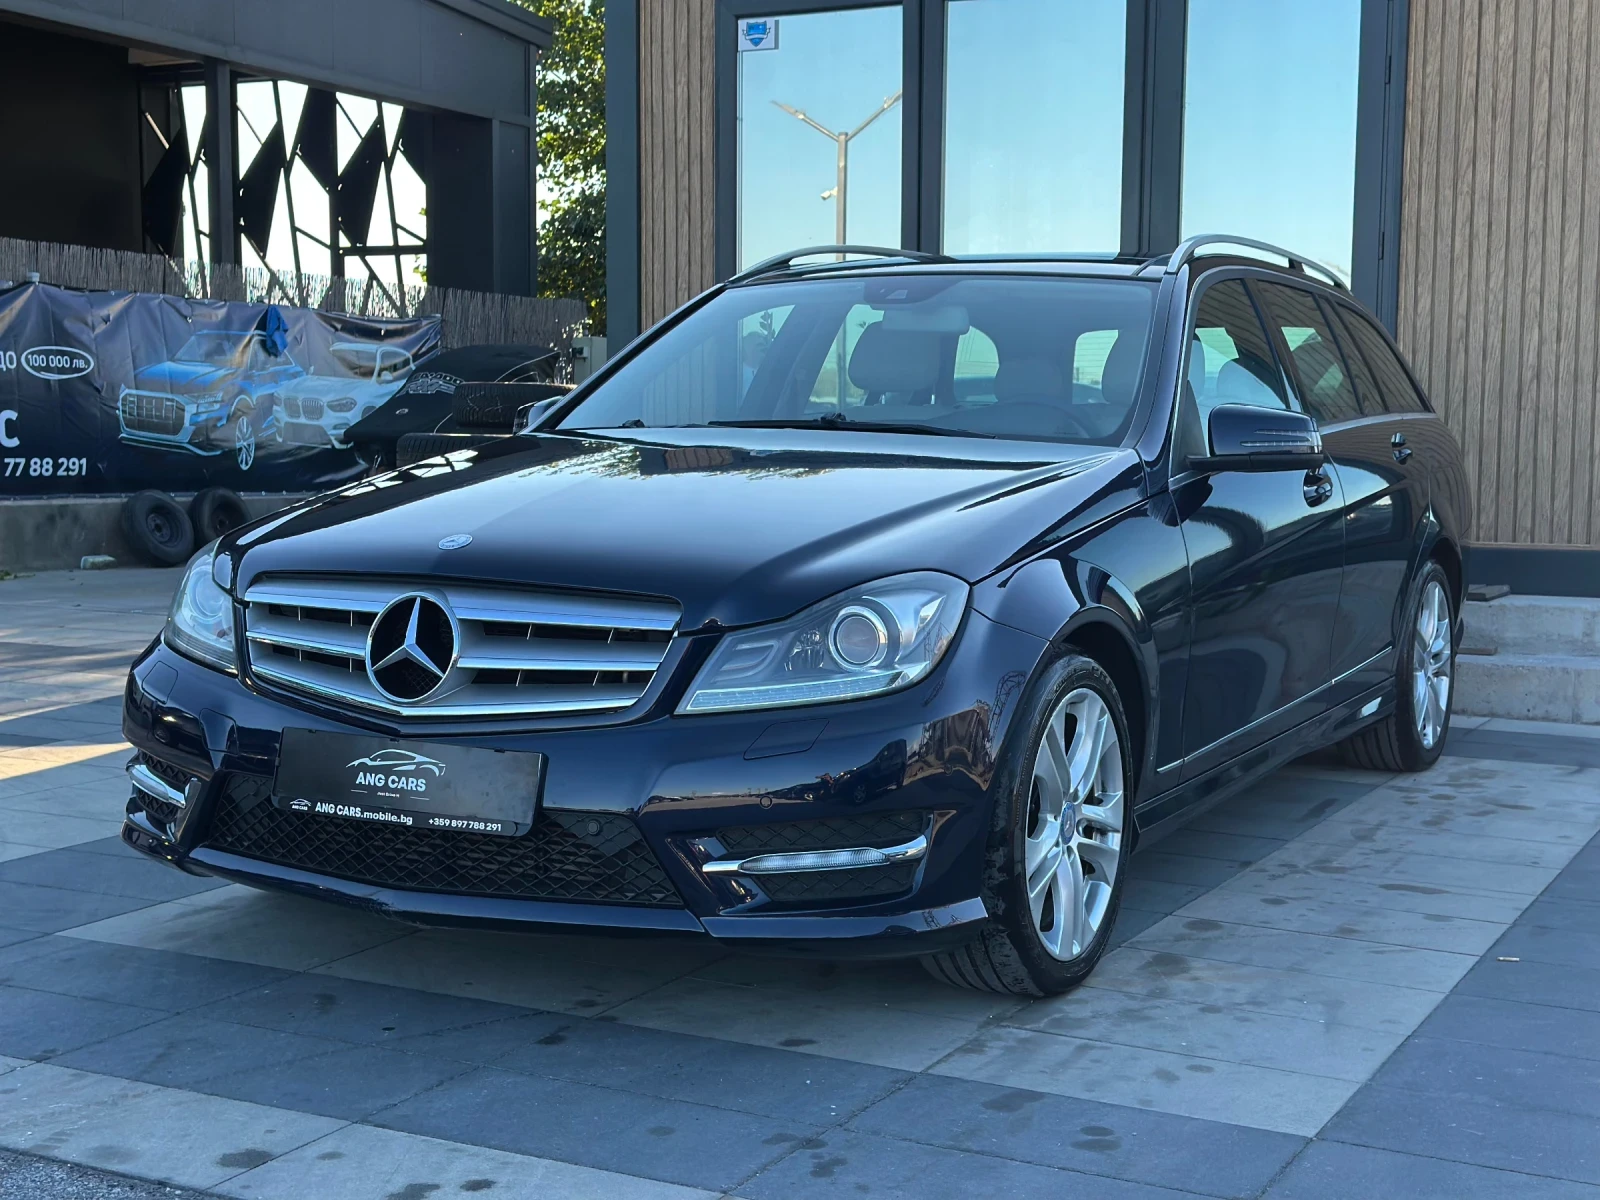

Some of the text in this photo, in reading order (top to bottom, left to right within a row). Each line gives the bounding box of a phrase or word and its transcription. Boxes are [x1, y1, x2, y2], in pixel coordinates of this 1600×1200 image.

[28, 355, 46, 367] 100
[49, 355, 70, 367] 000
[72, 359, 88, 368] лв.
[4, 457, 87, 477] 77 88 291
[355, 771, 426, 792] ANG CARS
[315, 801, 413, 825] ANG CARS.mobile.bg
[428, 817, 502, 832] +359 897 788 291
